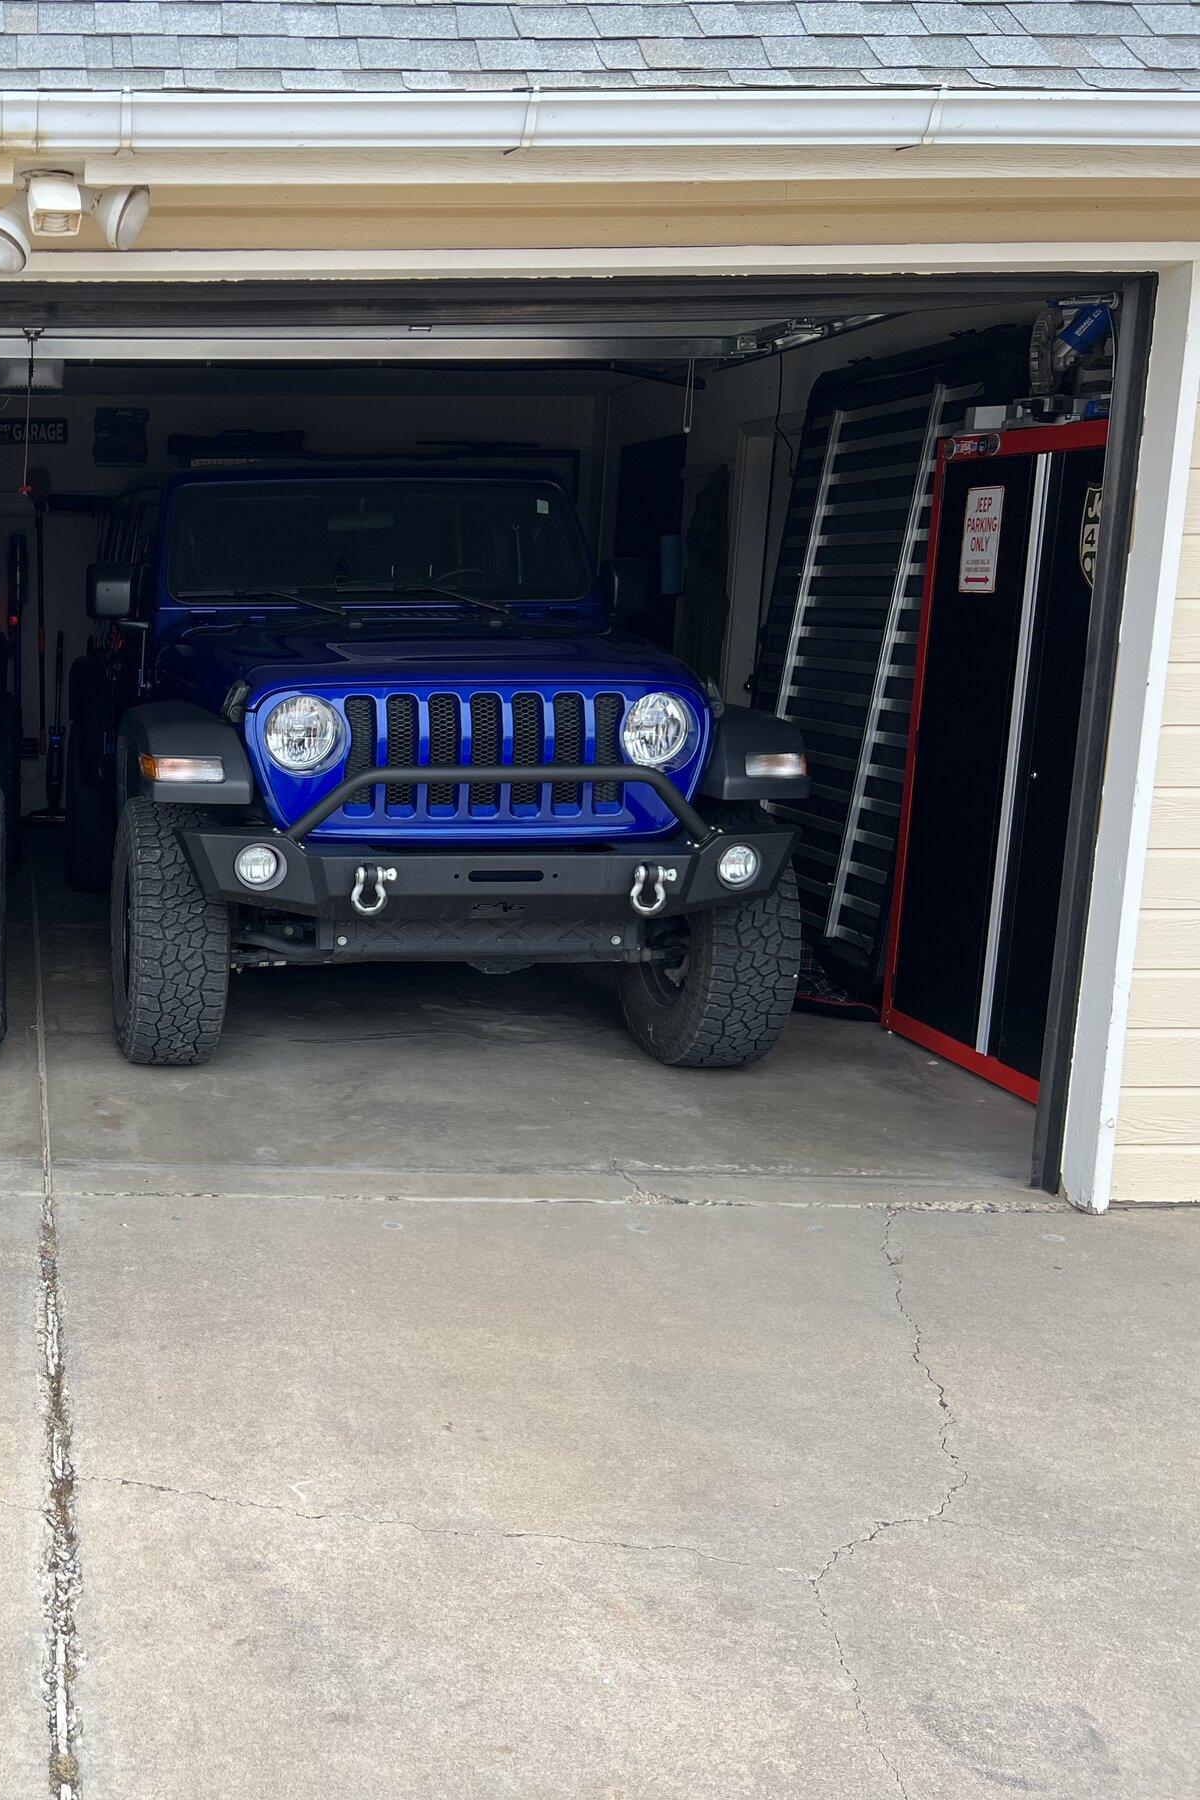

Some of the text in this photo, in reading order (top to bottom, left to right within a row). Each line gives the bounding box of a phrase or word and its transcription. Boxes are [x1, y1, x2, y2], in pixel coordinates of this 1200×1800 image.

[12, 423, 64, 441] GARAGE
[975, 496, 993, 513] JEEP
[966, 516, 998, 532] PARKING
[970, 536, 990, 552] ONLY
